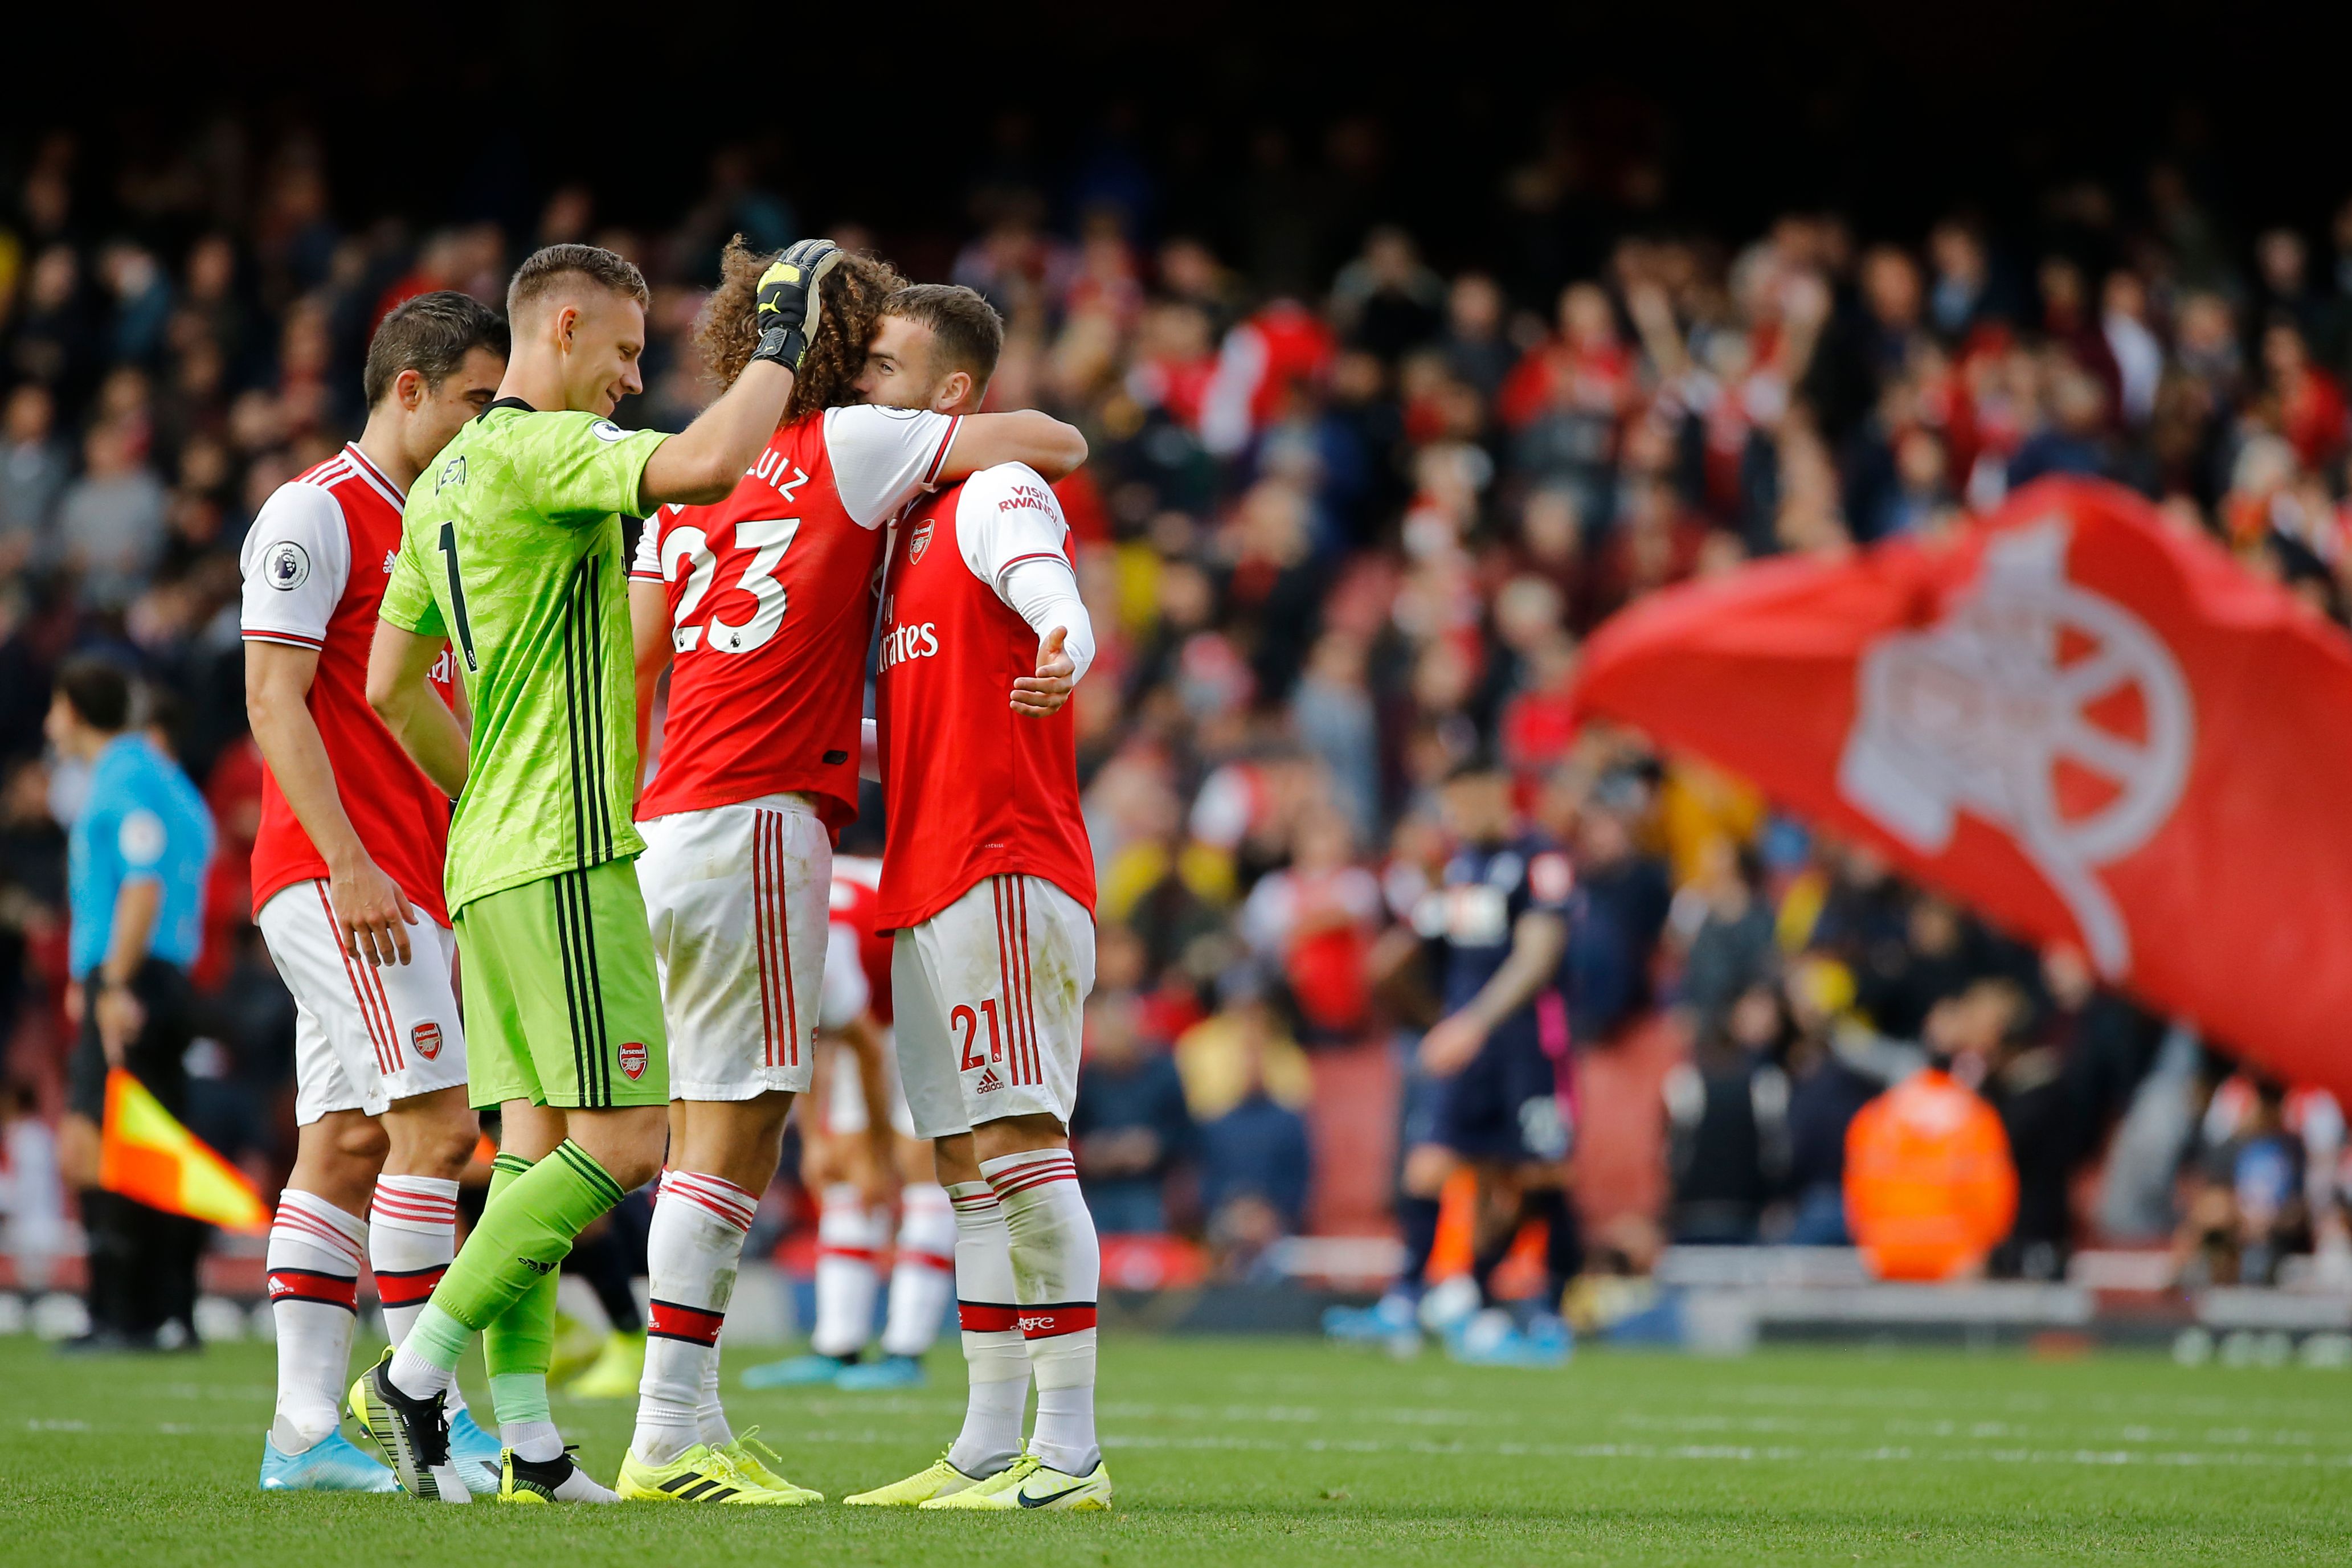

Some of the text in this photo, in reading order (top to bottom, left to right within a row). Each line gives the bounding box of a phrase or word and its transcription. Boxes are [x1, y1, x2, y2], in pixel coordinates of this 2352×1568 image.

[746, 447, 809, 503] UIZ
[1011, 485, 1049, 505] VISIT
[438, 521, 479, 674] 1
[660, 517, 801, 654] 23
[877, 621, 939, 674] irates
[950, 998, 1003, 1072] 21
[976, 1082, 1005, 1095] adidas
